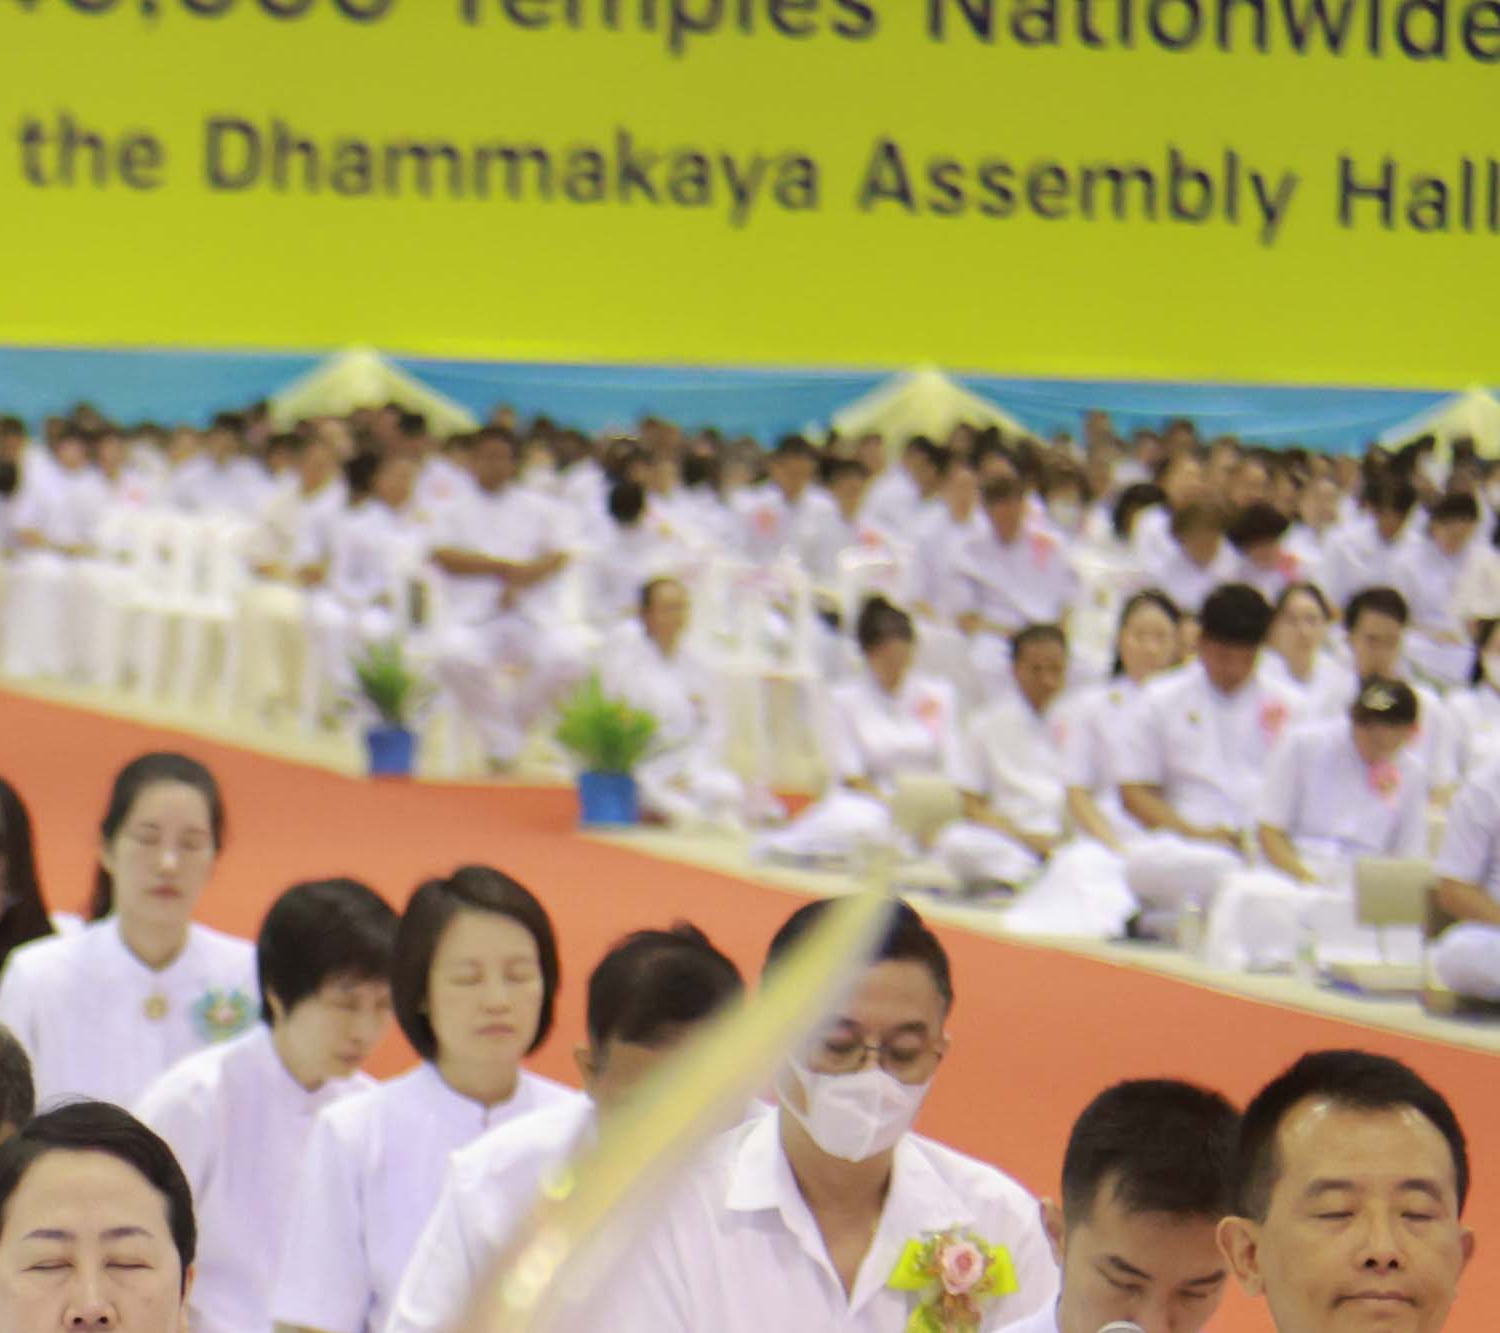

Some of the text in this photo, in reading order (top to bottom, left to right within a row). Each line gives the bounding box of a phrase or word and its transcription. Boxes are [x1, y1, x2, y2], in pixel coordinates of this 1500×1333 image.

[17, 112, 165, 191] the
[204, 115, 820, 228] Dhammakaya
[856, 136, 1299, 247] Assembly
[1337, 154, 1500, 235] Hall
